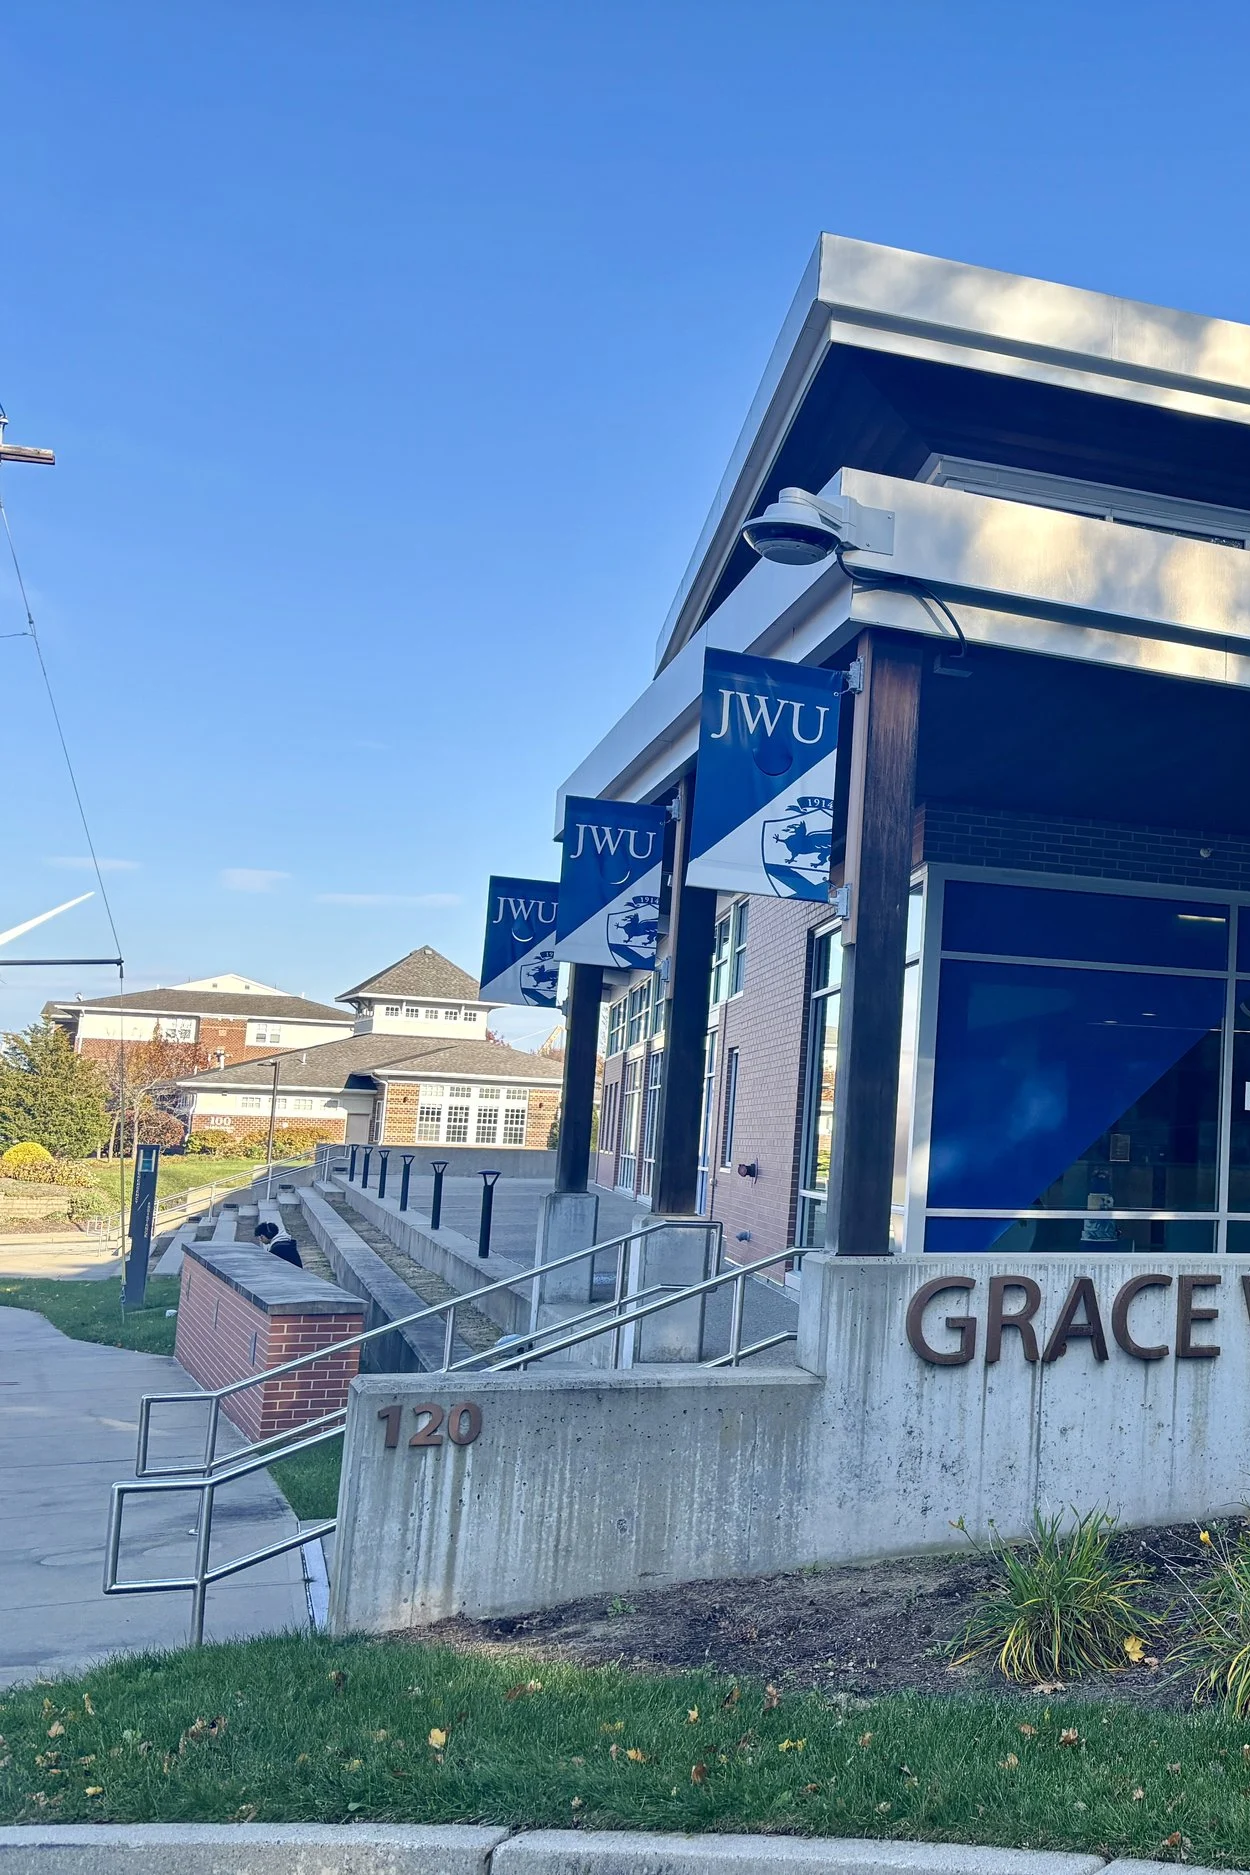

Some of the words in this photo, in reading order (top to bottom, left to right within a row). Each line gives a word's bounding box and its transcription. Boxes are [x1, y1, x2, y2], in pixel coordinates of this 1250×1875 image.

[709, 688, 829, 744] JWU
[807, 798, 834, 809] 1914
[569, 823, 657, 859] JWU
[492, 896, 559, 924] JWU
[640, 896, 659, 904] 1914
[210, 1116, 231, 1125] 100
[905, 1273, 1223, 1365] GRACE
[377, 1401, 483, 1449] 120
